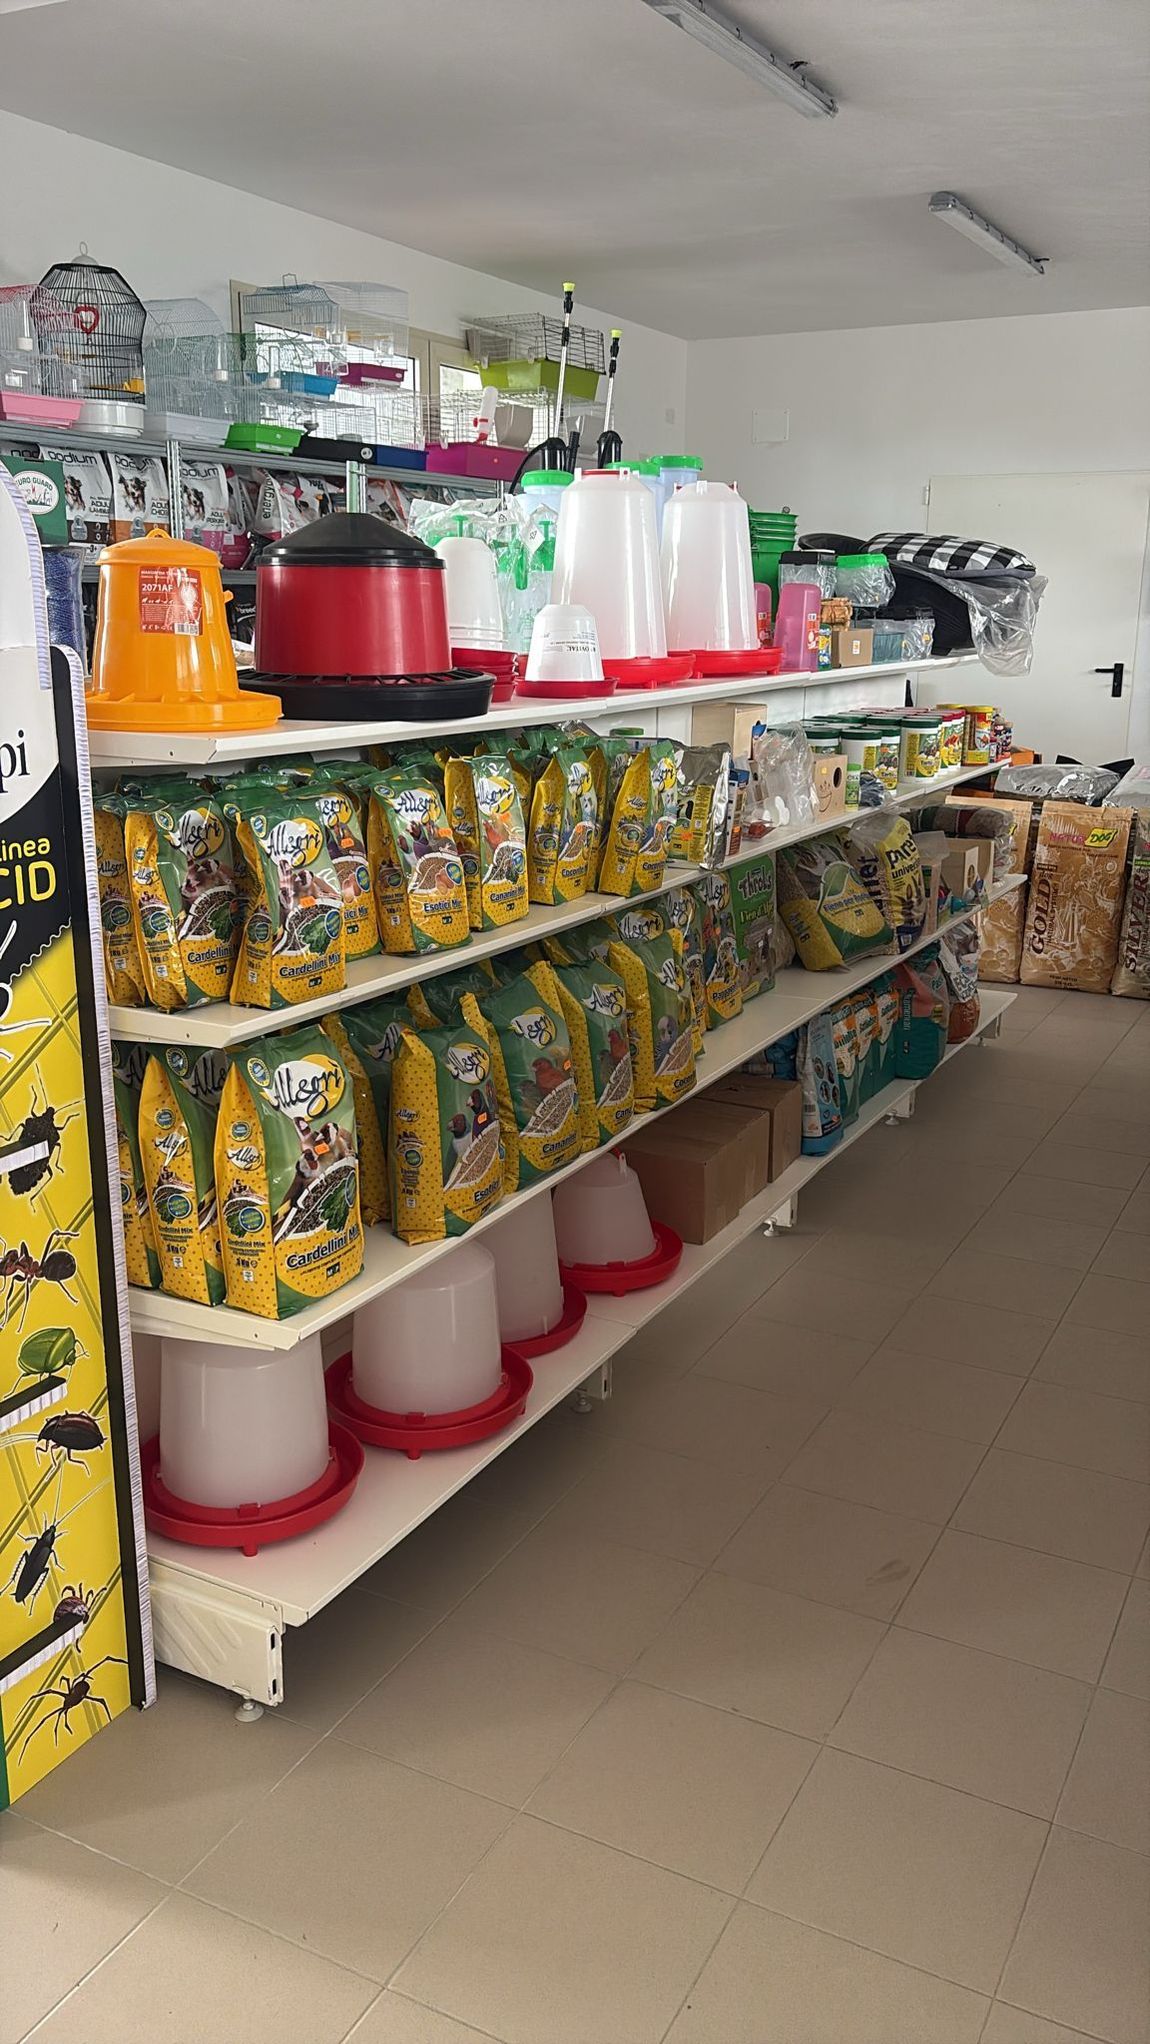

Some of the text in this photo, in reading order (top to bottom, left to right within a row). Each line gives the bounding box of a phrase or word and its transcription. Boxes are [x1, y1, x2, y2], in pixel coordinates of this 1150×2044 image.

[142, 583, 173, 592] 2071AF
[0, 729, 31, 793] pi
[0, 837, 51, 861] inea
[1031, 879, 1051, 955] GOLD
[1125, 873, 1149, 974] SILVER
[279, 960, 327, 978] Cardellini
[286, 1235, 347, 1270] Cardellini
